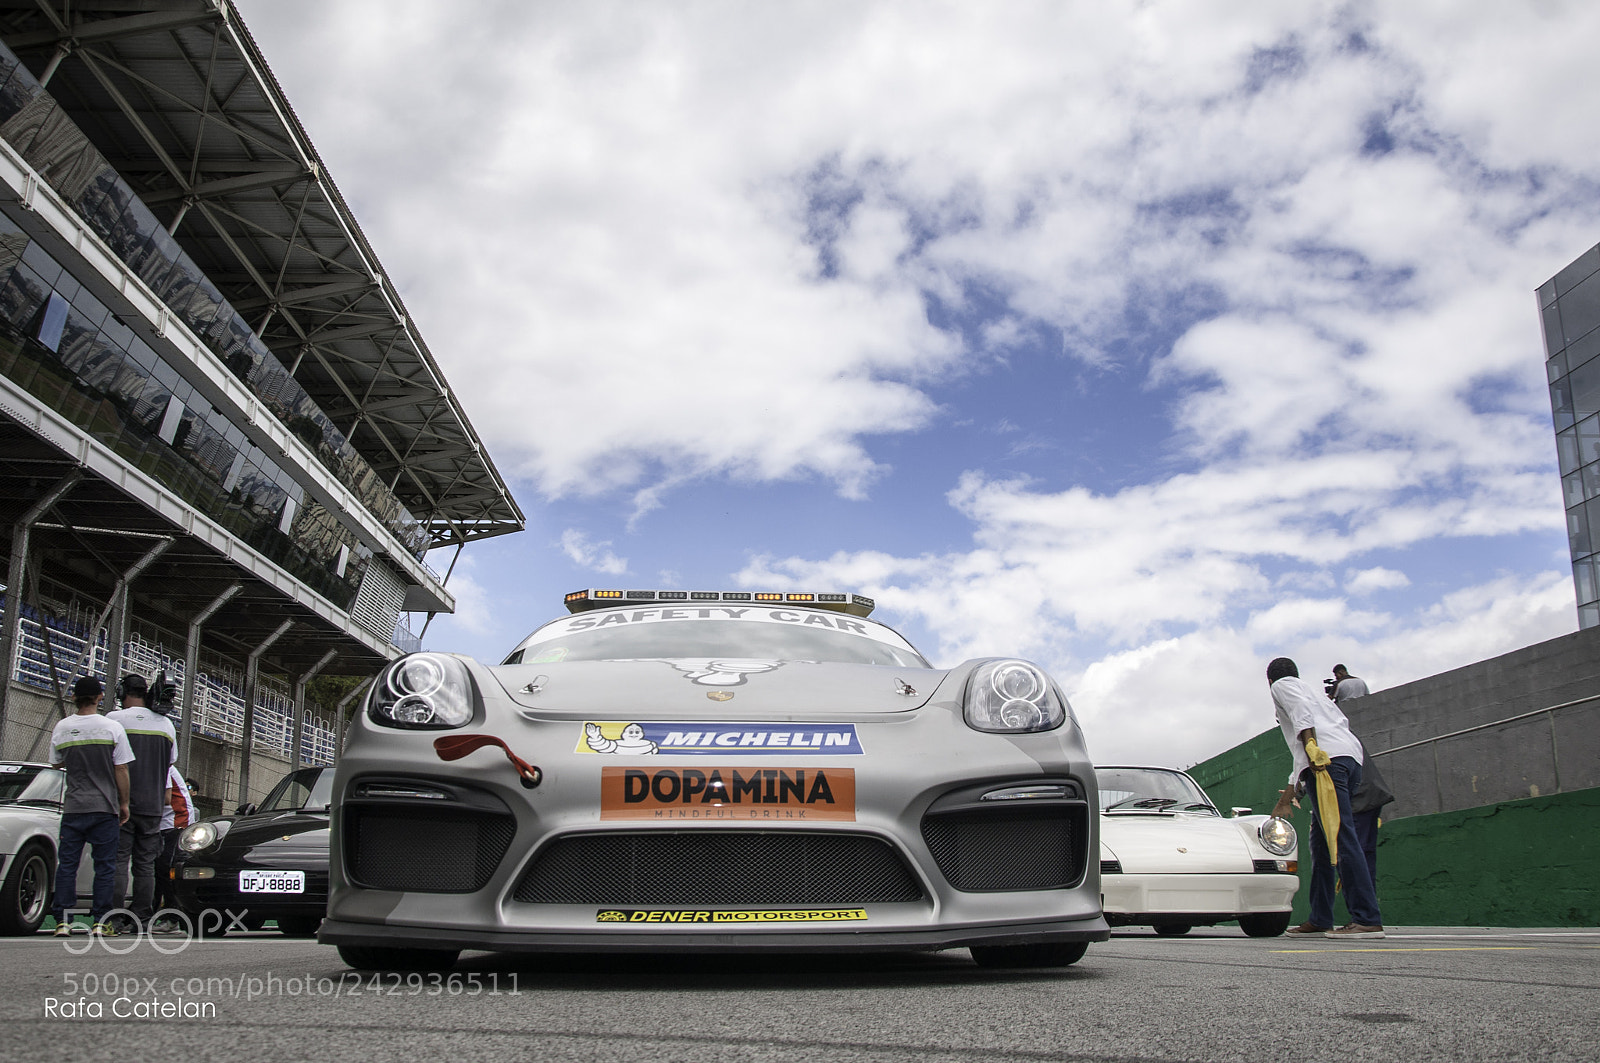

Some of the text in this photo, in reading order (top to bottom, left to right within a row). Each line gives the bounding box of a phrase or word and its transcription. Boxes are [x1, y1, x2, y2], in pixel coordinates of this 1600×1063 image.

[566, 608, 868, 635] SAFETY CAR
[661, 732, 852, 747] MICHELIN
[624, 769, 836, 804] DOPAMINA
[655, 810, 807, 819] MINDFUL DRINK
[629, 910, 862, 922] DENER MOTORSPORT
